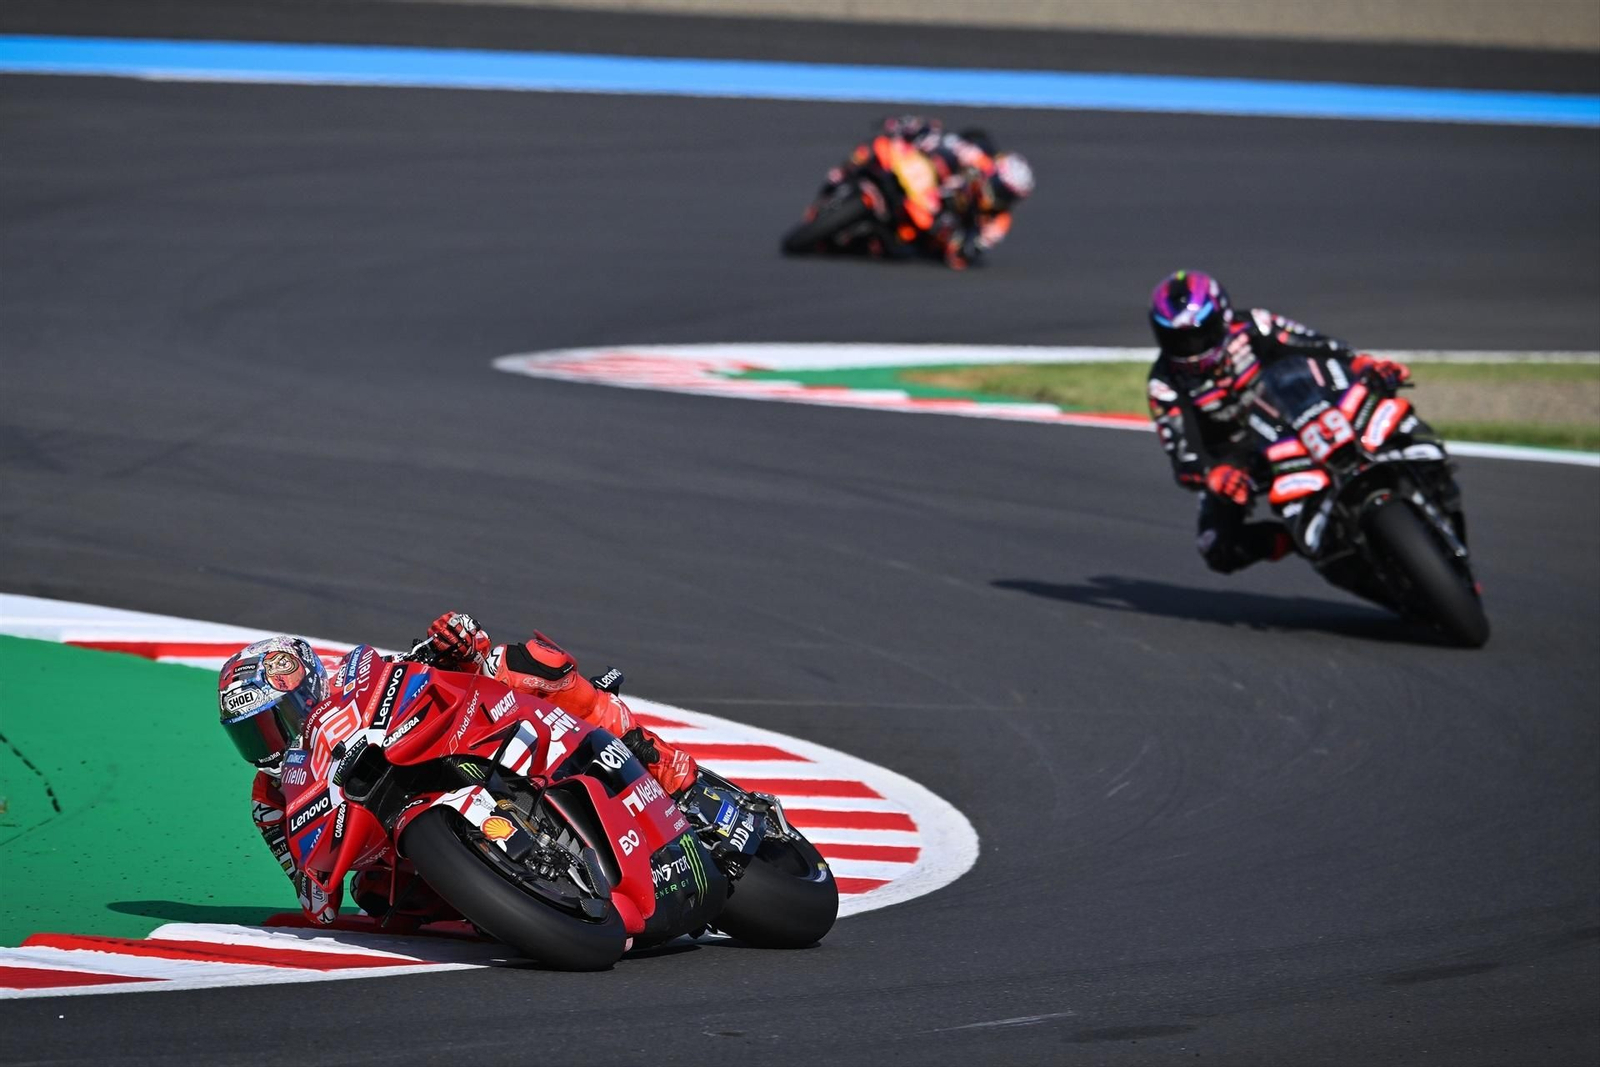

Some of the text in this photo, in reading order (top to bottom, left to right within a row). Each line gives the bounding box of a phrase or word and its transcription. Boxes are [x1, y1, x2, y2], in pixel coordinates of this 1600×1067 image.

[234, 664, 256, 673] Lenovo
[595, 668, 622, 689] Lenovo
[228, 691, 254, 710] SHOEI
[373, 668, 403, 726] Lenovo
[490, 690, 517, 722] DUCATI
[456, 689, 480, 740] Audi Sport
[382, 716, 420, 748] CARRERA
[291, 797, 329, 832] Lenovo
[335, 803, 346, 838] CARRERA
[651, 855, 691, 888] ONSTER
